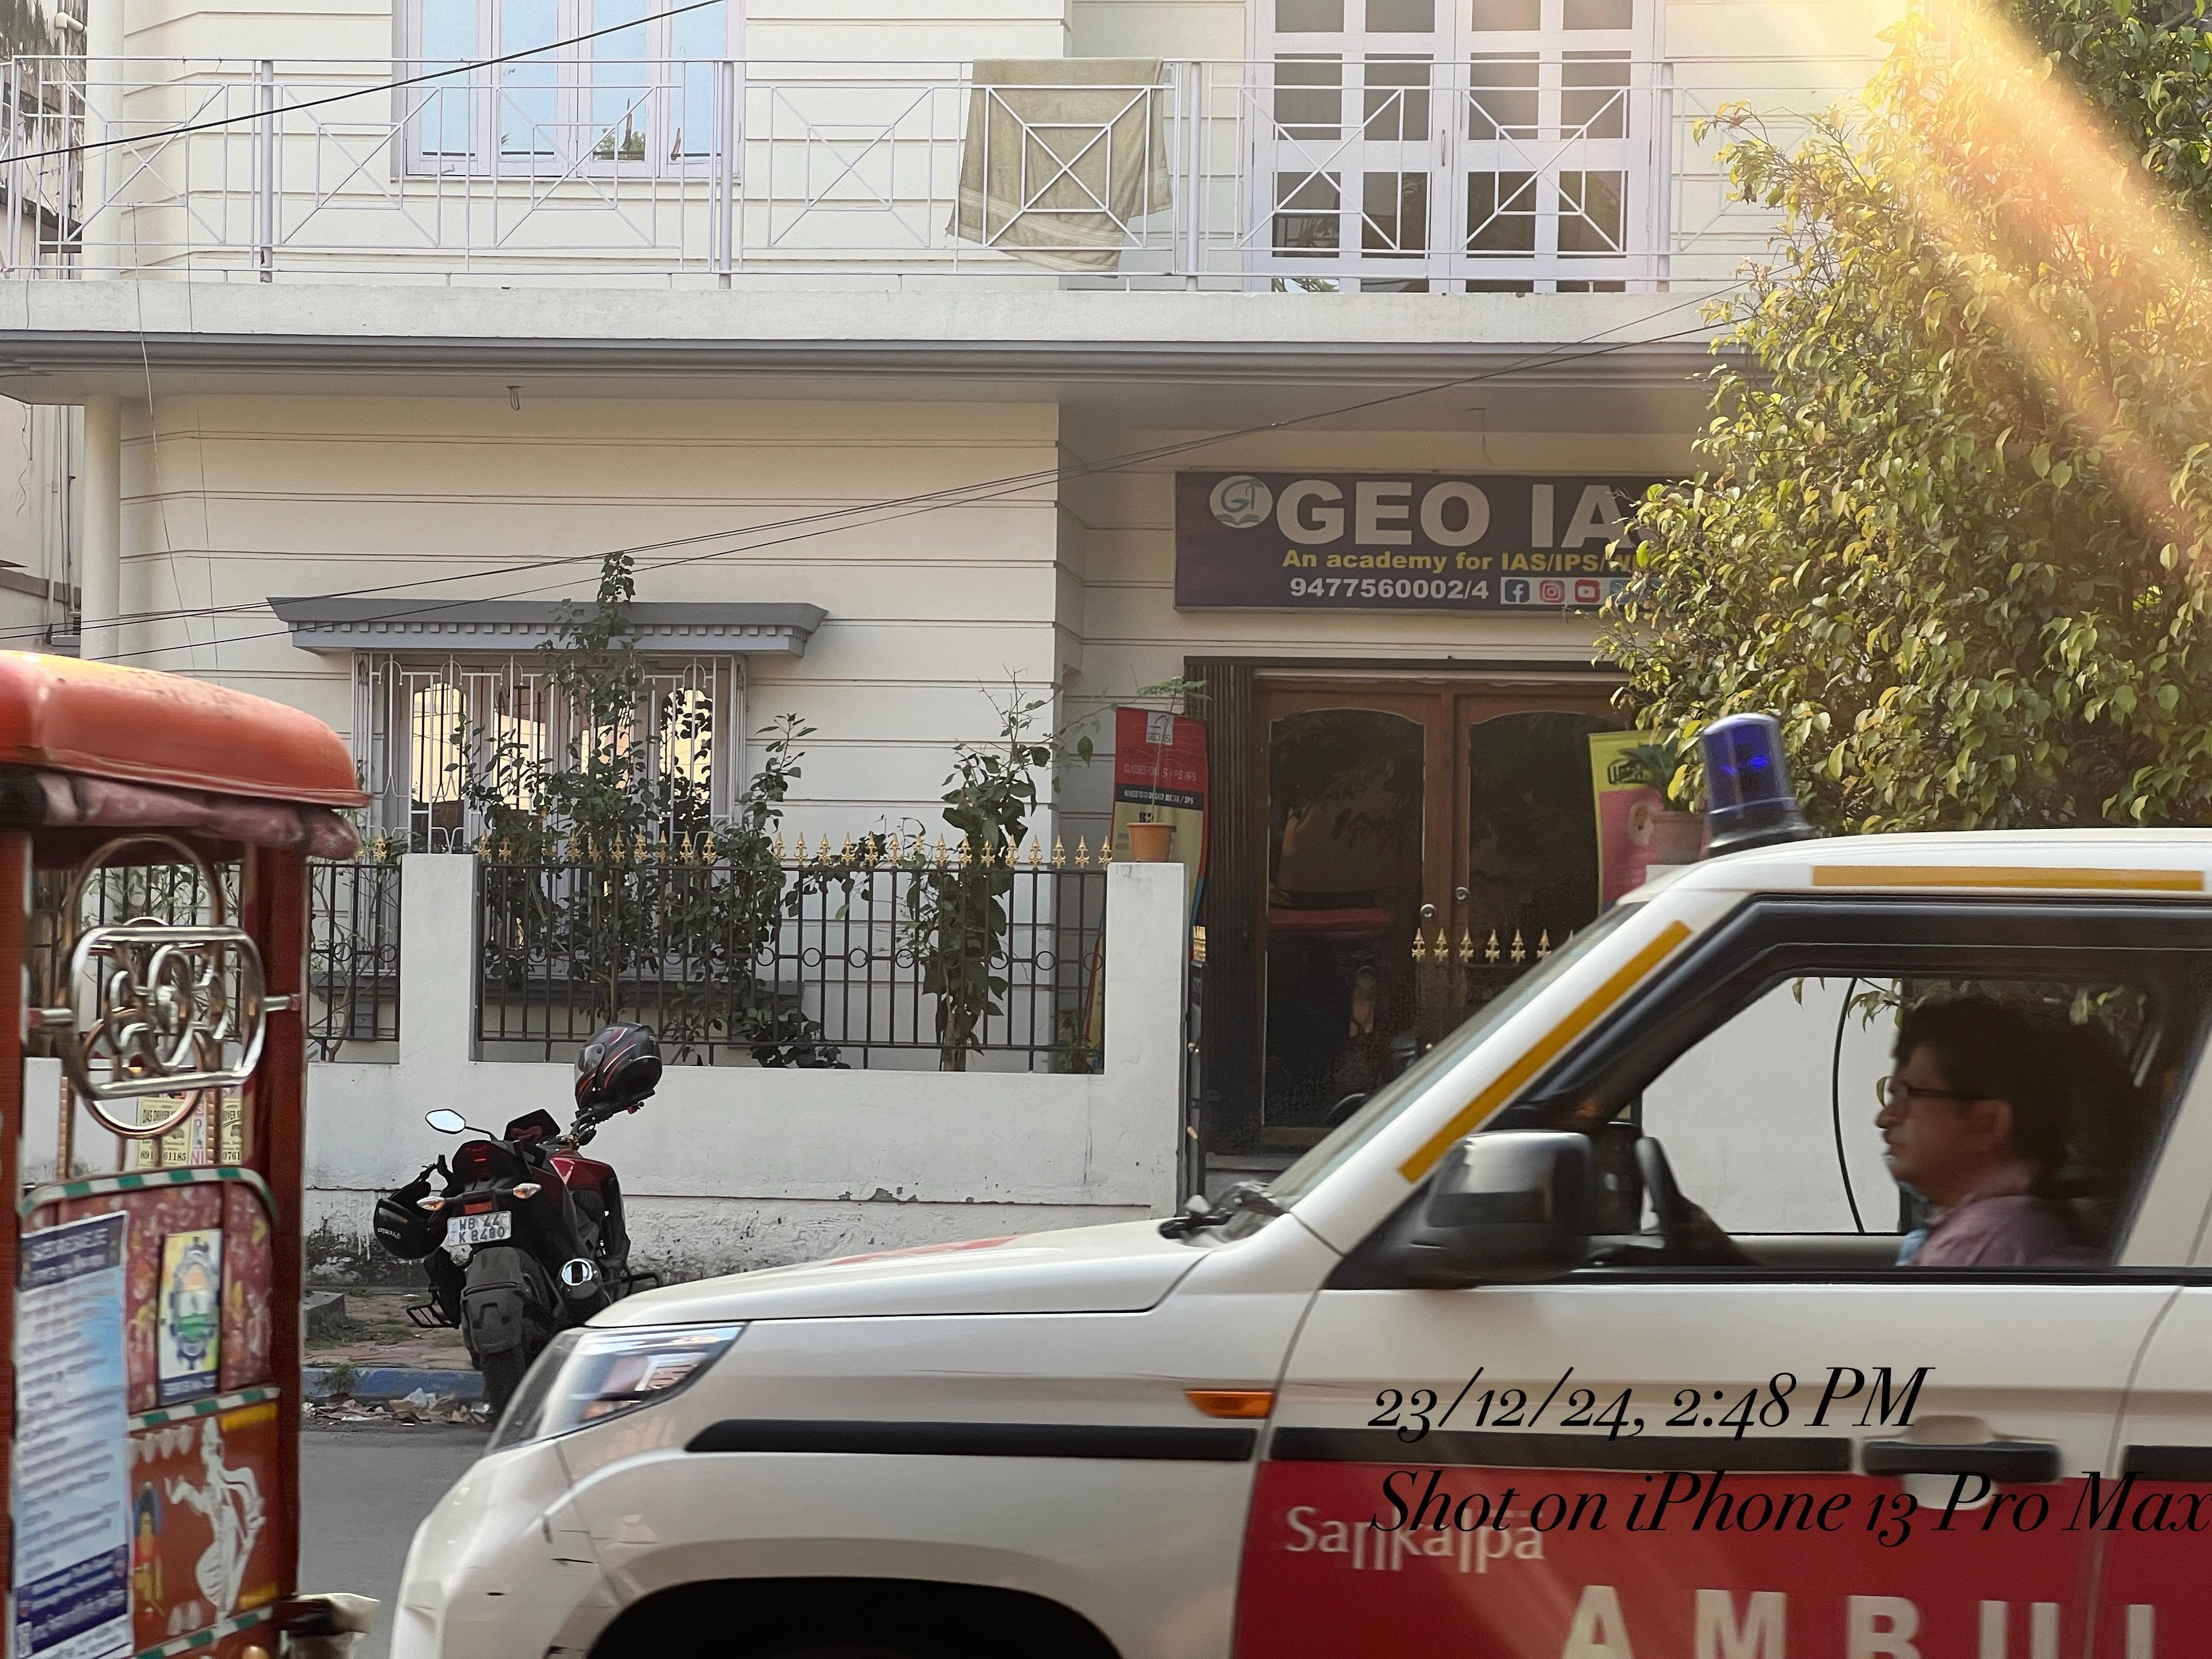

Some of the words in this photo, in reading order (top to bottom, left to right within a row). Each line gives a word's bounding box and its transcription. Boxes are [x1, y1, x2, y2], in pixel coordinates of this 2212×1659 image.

[1277, 479, 1490, 547] GEO
[1531, 484, 1695, 549] IA
[1282, 549, 1317, 567] An
[1326, 551, 1447, 573] academy
[1456, 552, 1493, 570] for
[1290, 577, 1489, 599] 9477560002/4
[459, 1217, 475, 1231] WB
[459, 1231, 466, 1244] K
